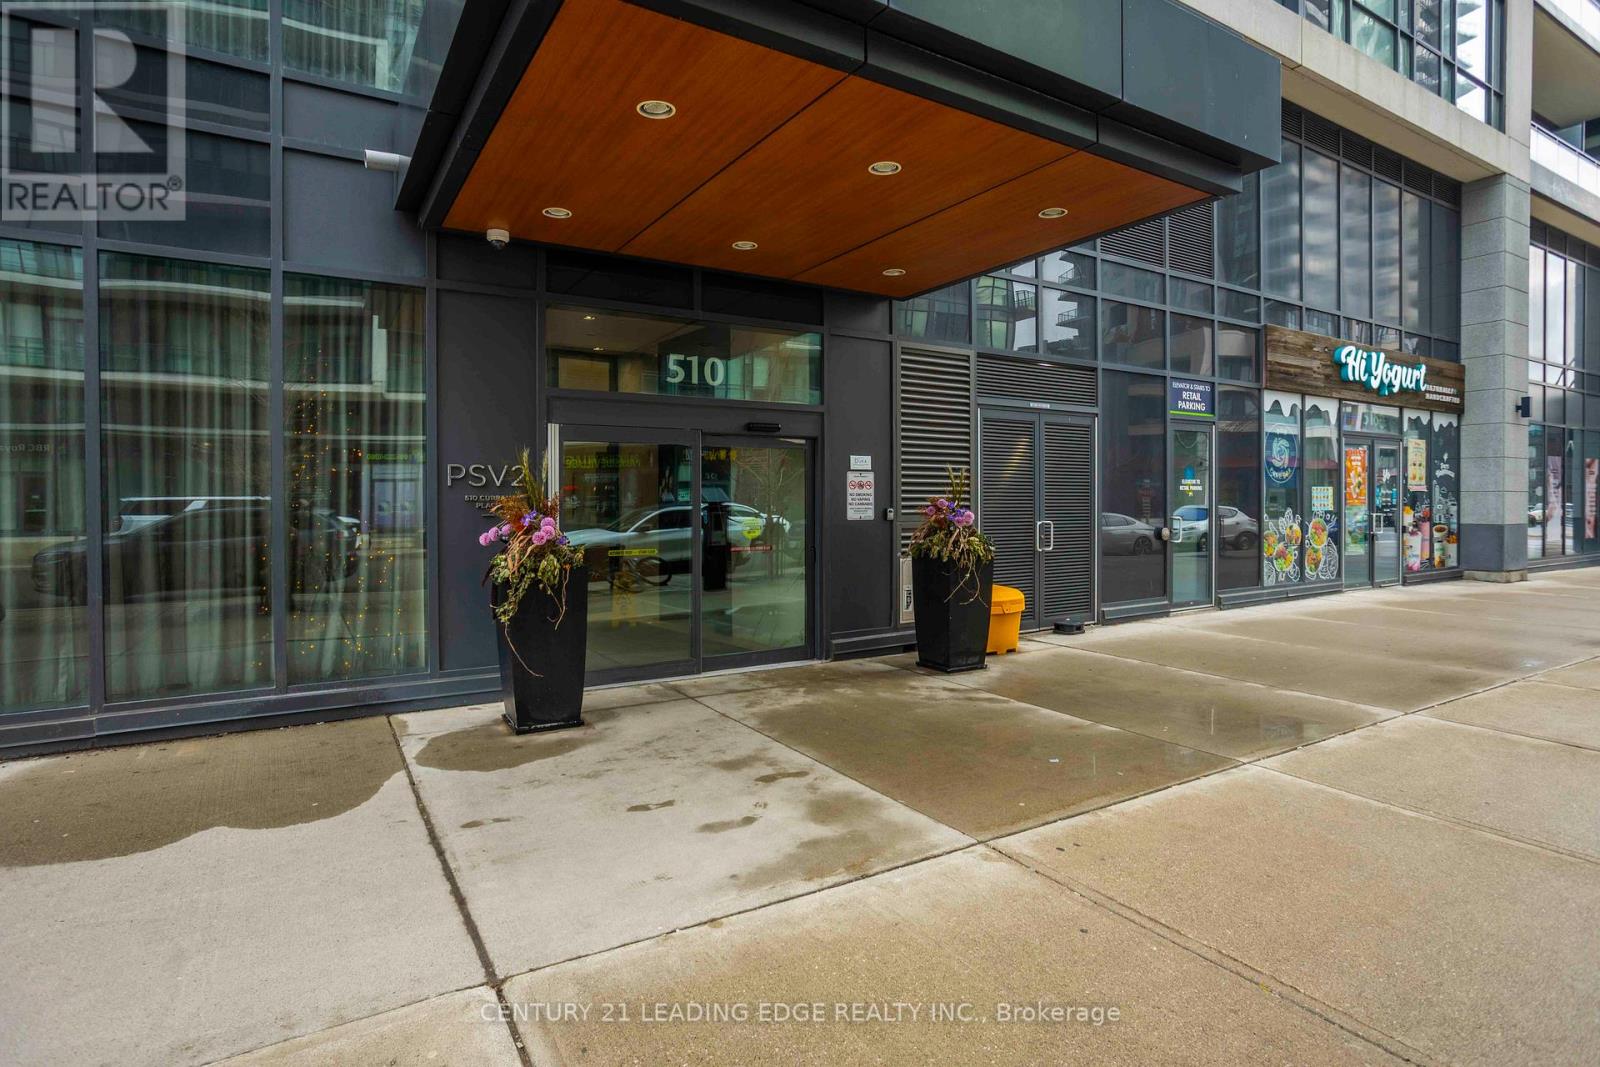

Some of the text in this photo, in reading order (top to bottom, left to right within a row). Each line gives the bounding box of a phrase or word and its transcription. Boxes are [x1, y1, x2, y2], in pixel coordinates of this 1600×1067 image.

[665, 352, 725, 387] 510
[1337, 345, 1427, 396] Hi Yogurt
[1172, 381, 1190, 390] ELEVATOR
[1182, 391, 1202, 401] RETAIL
[1178, 400, 1206, 411] PARKING
[446, 463, 525, 487] PSV2
